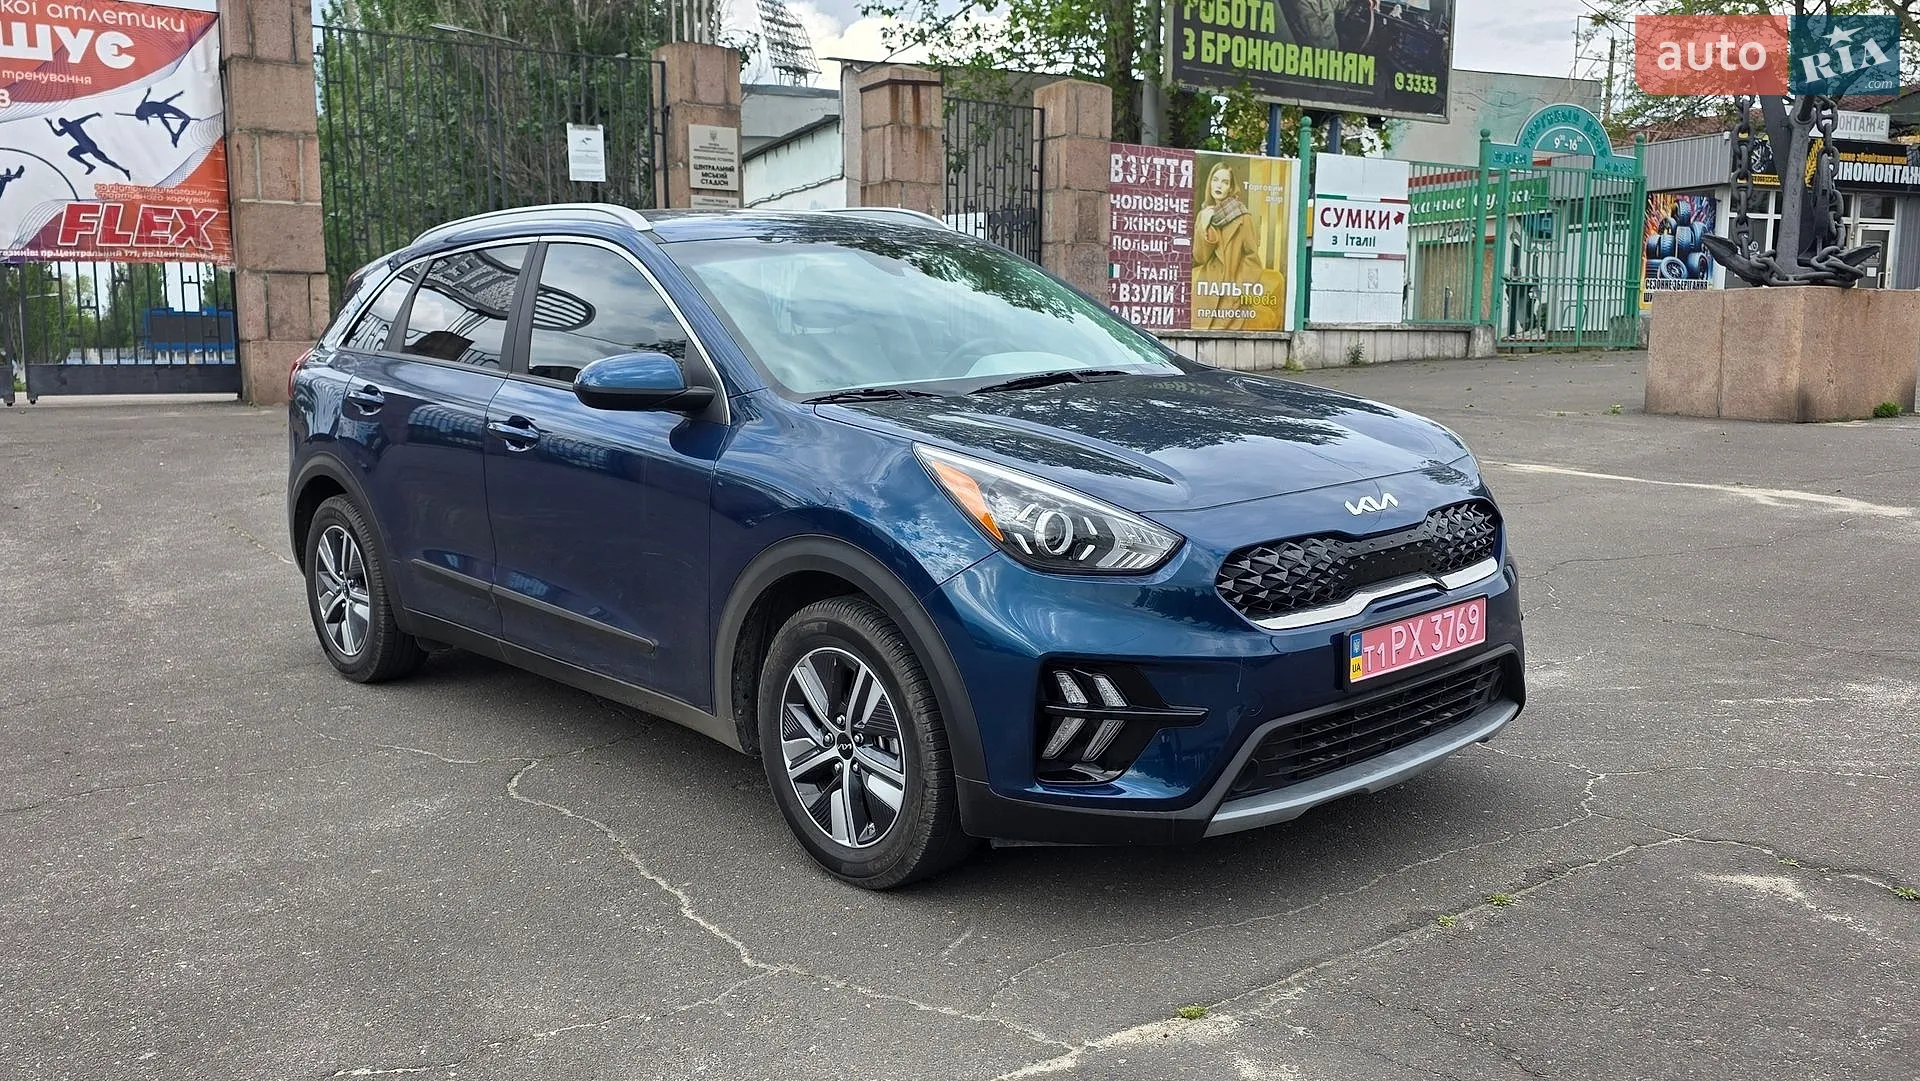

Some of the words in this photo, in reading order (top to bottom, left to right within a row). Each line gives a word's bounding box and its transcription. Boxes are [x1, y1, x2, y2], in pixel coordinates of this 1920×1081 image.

[46, 3, 186, 33] атлетики
[1201, 30, 1376, 86] БРОНЮВАННЯМ
[2, 70, 92, 85] тренування
[1405, 73, 1437, 95] 3333
[1839, 114, 1877, 133] ОНТАЖ
[1110, 153, 1193, 189] ВЗУТТЯ
[1834, 161, 1920, 185] ИНОМОНТАЖ
[57, 202, 219, 251] FLEX
[1320, 206, 1391, 231] СУМКИ
[1197, 281, 1264, 297] ПАЛЬТО
[1240, 291, 1277, 306] moda
[1197, 308, 1257, 320] ПРАЦЮЄМО
[1352, 663, 1361, 674] UA
